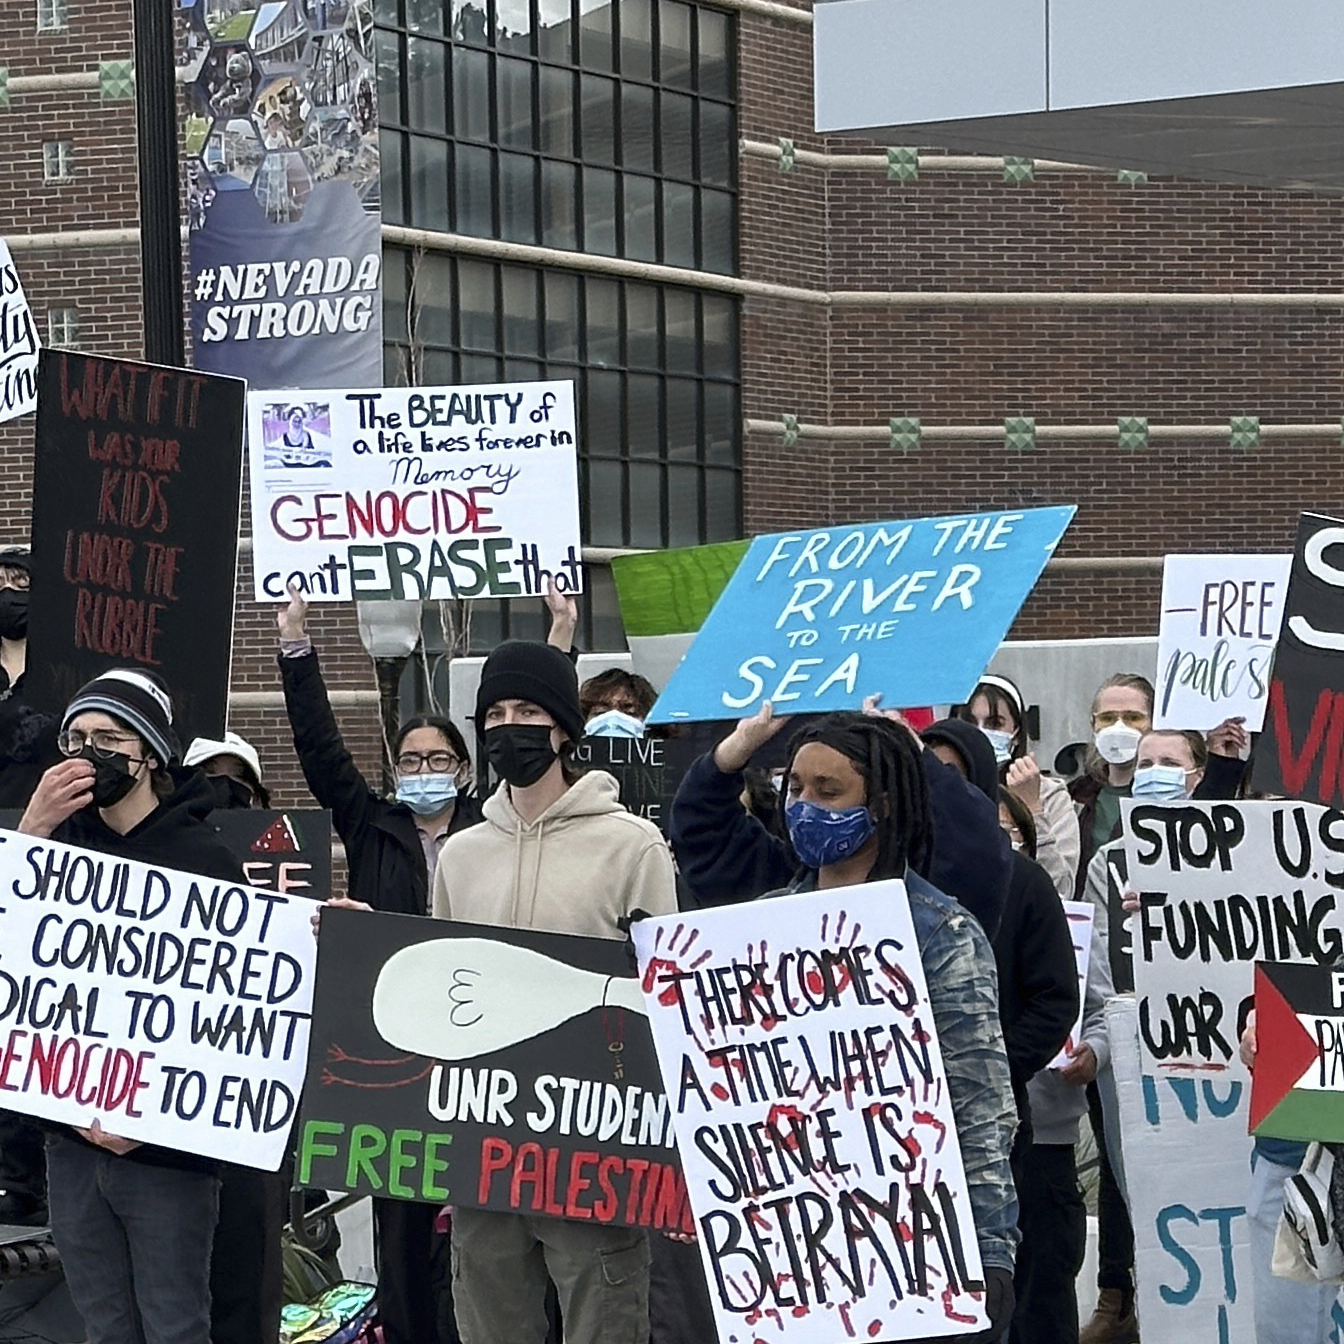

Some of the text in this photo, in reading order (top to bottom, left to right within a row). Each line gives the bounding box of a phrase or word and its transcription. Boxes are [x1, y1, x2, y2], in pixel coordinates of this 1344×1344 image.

[196, 253, 381, 302] #NEVADA
[203, 296, 372, 343] STRONG
[60, 354, 208, 430] WHAT IF IT
[345, 391, 557, 430] The BEAUTY of
[87, 429, 182, 473] WAS YOUR
[352, 438, 374, 455] a
[378, 430, 414, 454] life
[474, 427, 547, 451] forever
[549, 429, 574, 447] in
[97, 466, 170, 534] KIDS
[389, 457, 522, 496] Memory
[270, 486, 503, 542] GENOCIDE
[756, 514, 1025, 582] FROM THE
[63, 528, 185, 601] UNDER THE
[348, 537, 522, 601] ERASE
[514, 543, 585, 595] that
[775, 563, 982, 631] RIVER
[74, 587, 168, 666] RUBBLE
[786, 619, 901, 649] TO THE
[1199, 579, 1276, 641] FREE
[721, 652, 862, 710] SEA
[608, 737, 665, 767] LIVE
[1129, 803, 1246, 872] STOP
[12, 845, 172, 922] SHOULD
[180, 881, 289, 944] NOT
[31, 912, 303, 1005] CONSIDERED
[657, 937, 918, 1036] THERE COMES
[125, 990, 176, 1044] TO
[191, 1000, 313, 1062] WANT
[1138, 985, 1235, 1062] WAR
[677, 1016, 935, 1114] A TIME WHEN
[160, 1065, 207, 1122] TO
[212, 1074, 296, 1134] END
[426, 1064, 677, 1149] UNR STUDEN
[298, 1119, 697, 1235] FREE PALESTIN
[693, 1101, 917, 1205] SILENCE IS
[699, 1180, 988, 1314] BETRAYAL
